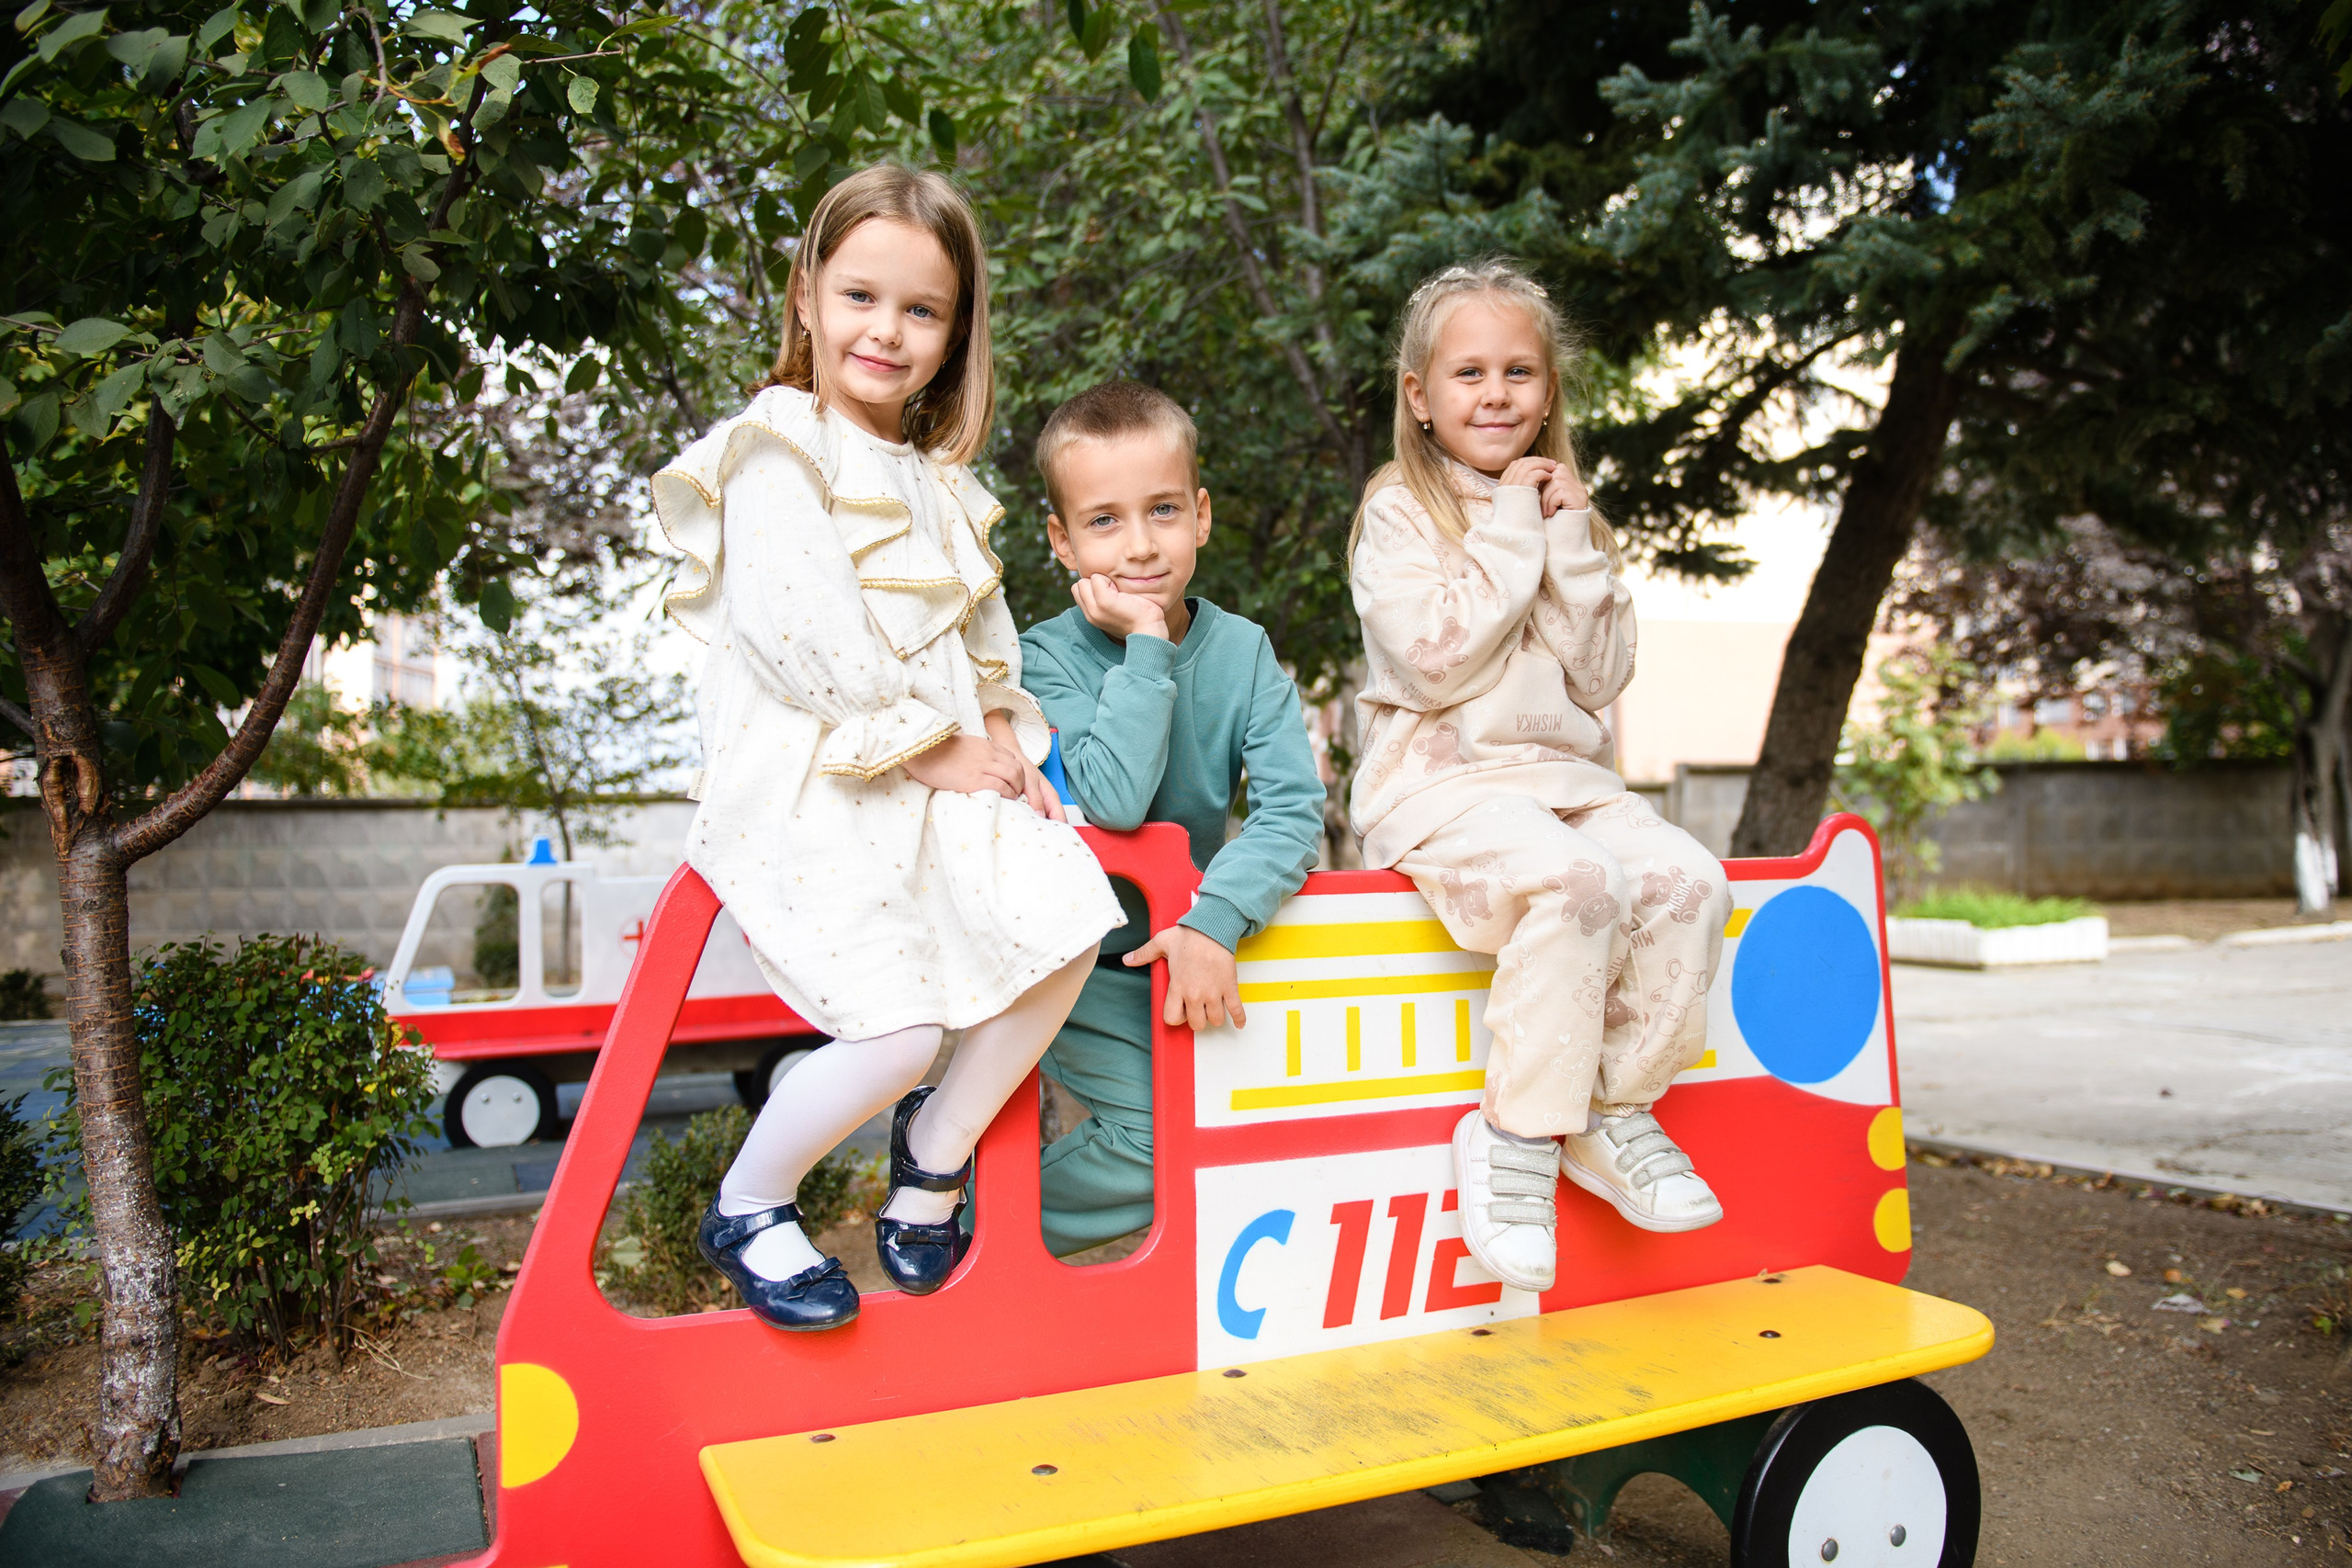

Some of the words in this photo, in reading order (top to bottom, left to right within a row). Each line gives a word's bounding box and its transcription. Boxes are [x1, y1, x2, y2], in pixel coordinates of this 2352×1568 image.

[1408, 682, 1442, 708] MISHKA
[1517, 714, 1563, 732] MISHKA
[1666, 874, 1694, 915] MISHKA
